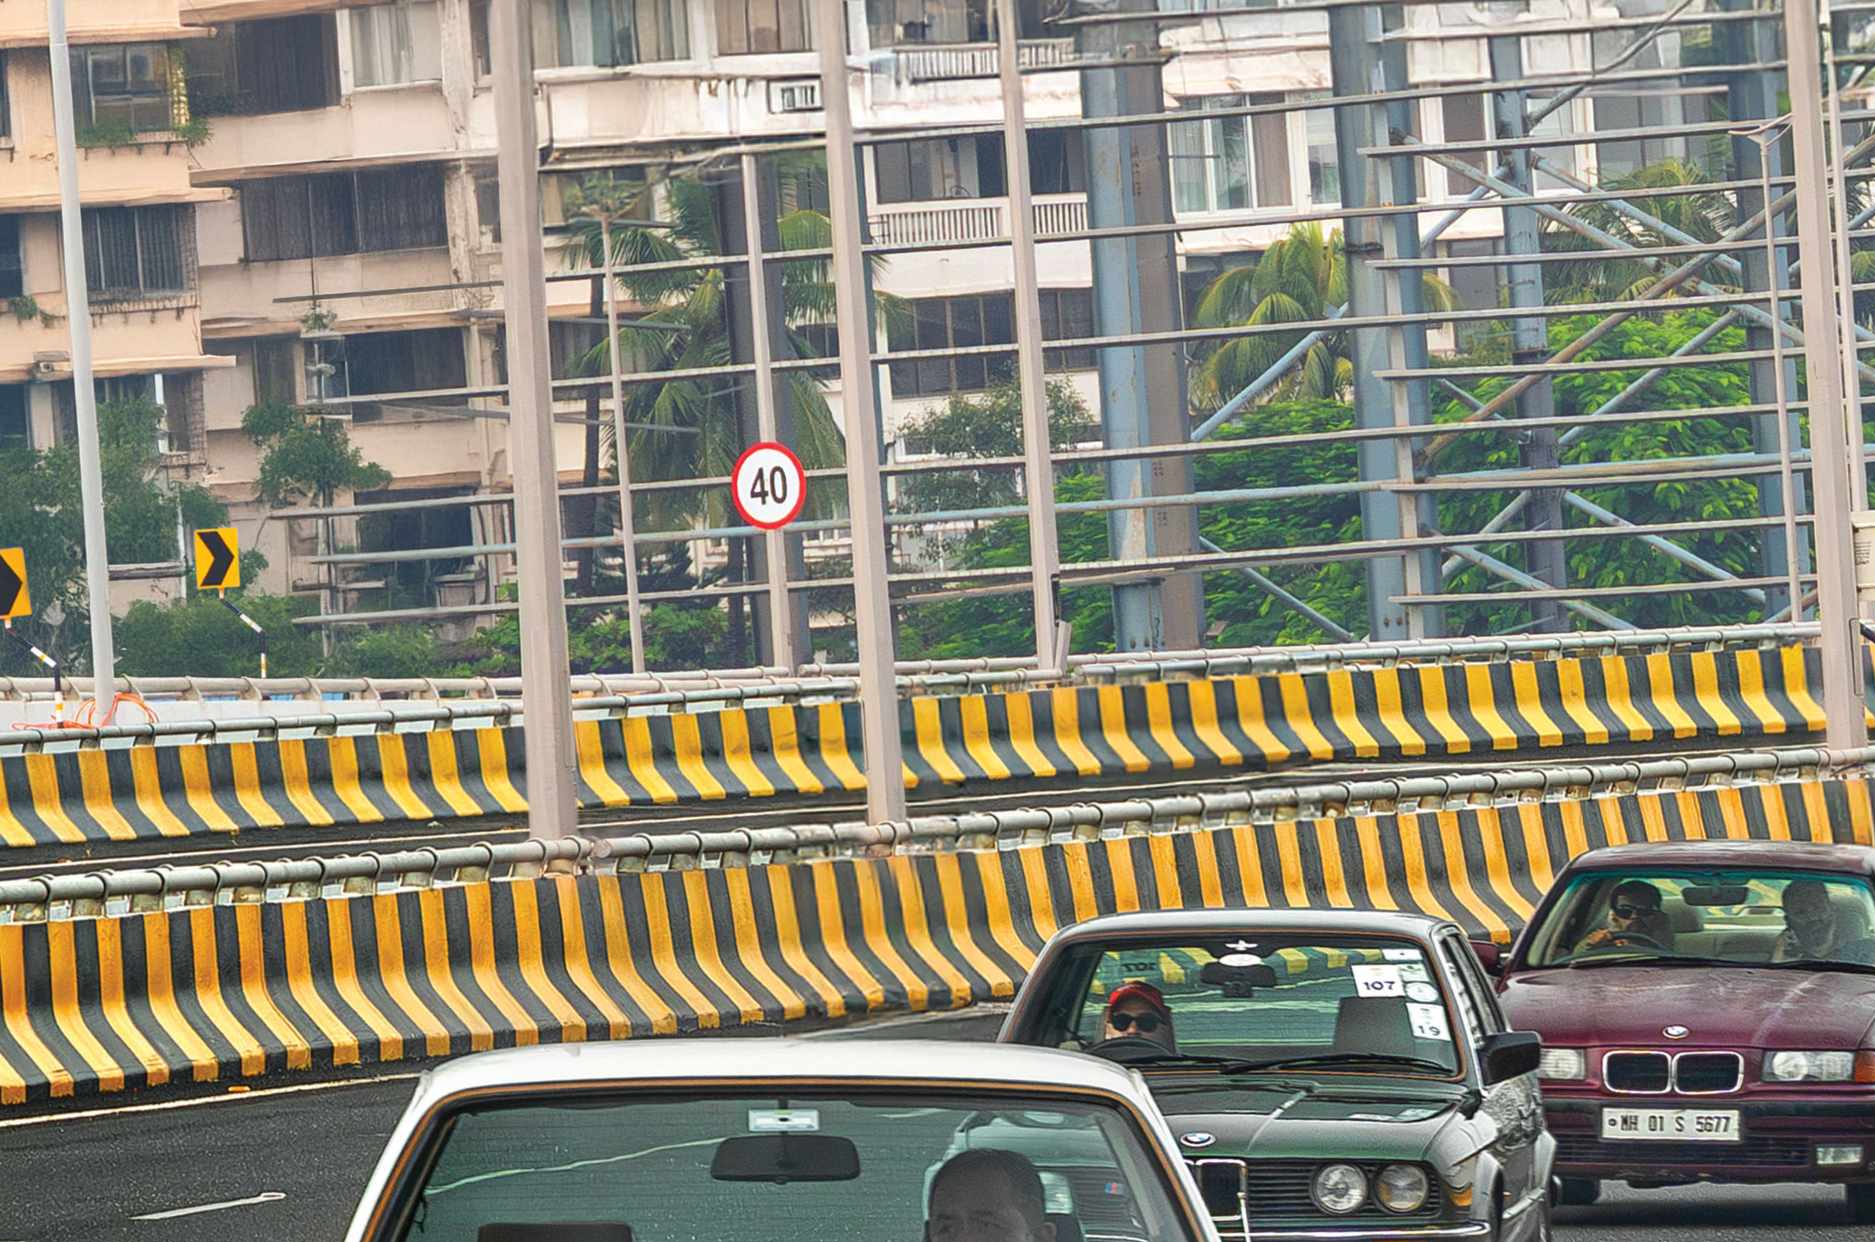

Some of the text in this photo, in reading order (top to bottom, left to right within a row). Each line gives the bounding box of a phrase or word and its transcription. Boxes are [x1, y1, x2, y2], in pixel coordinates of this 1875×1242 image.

[750, 465, 788, 505] 40
[1363, 980, 1395, 991] 107
[1620, 1115, 1730, 1133] MH 01 S 5677
